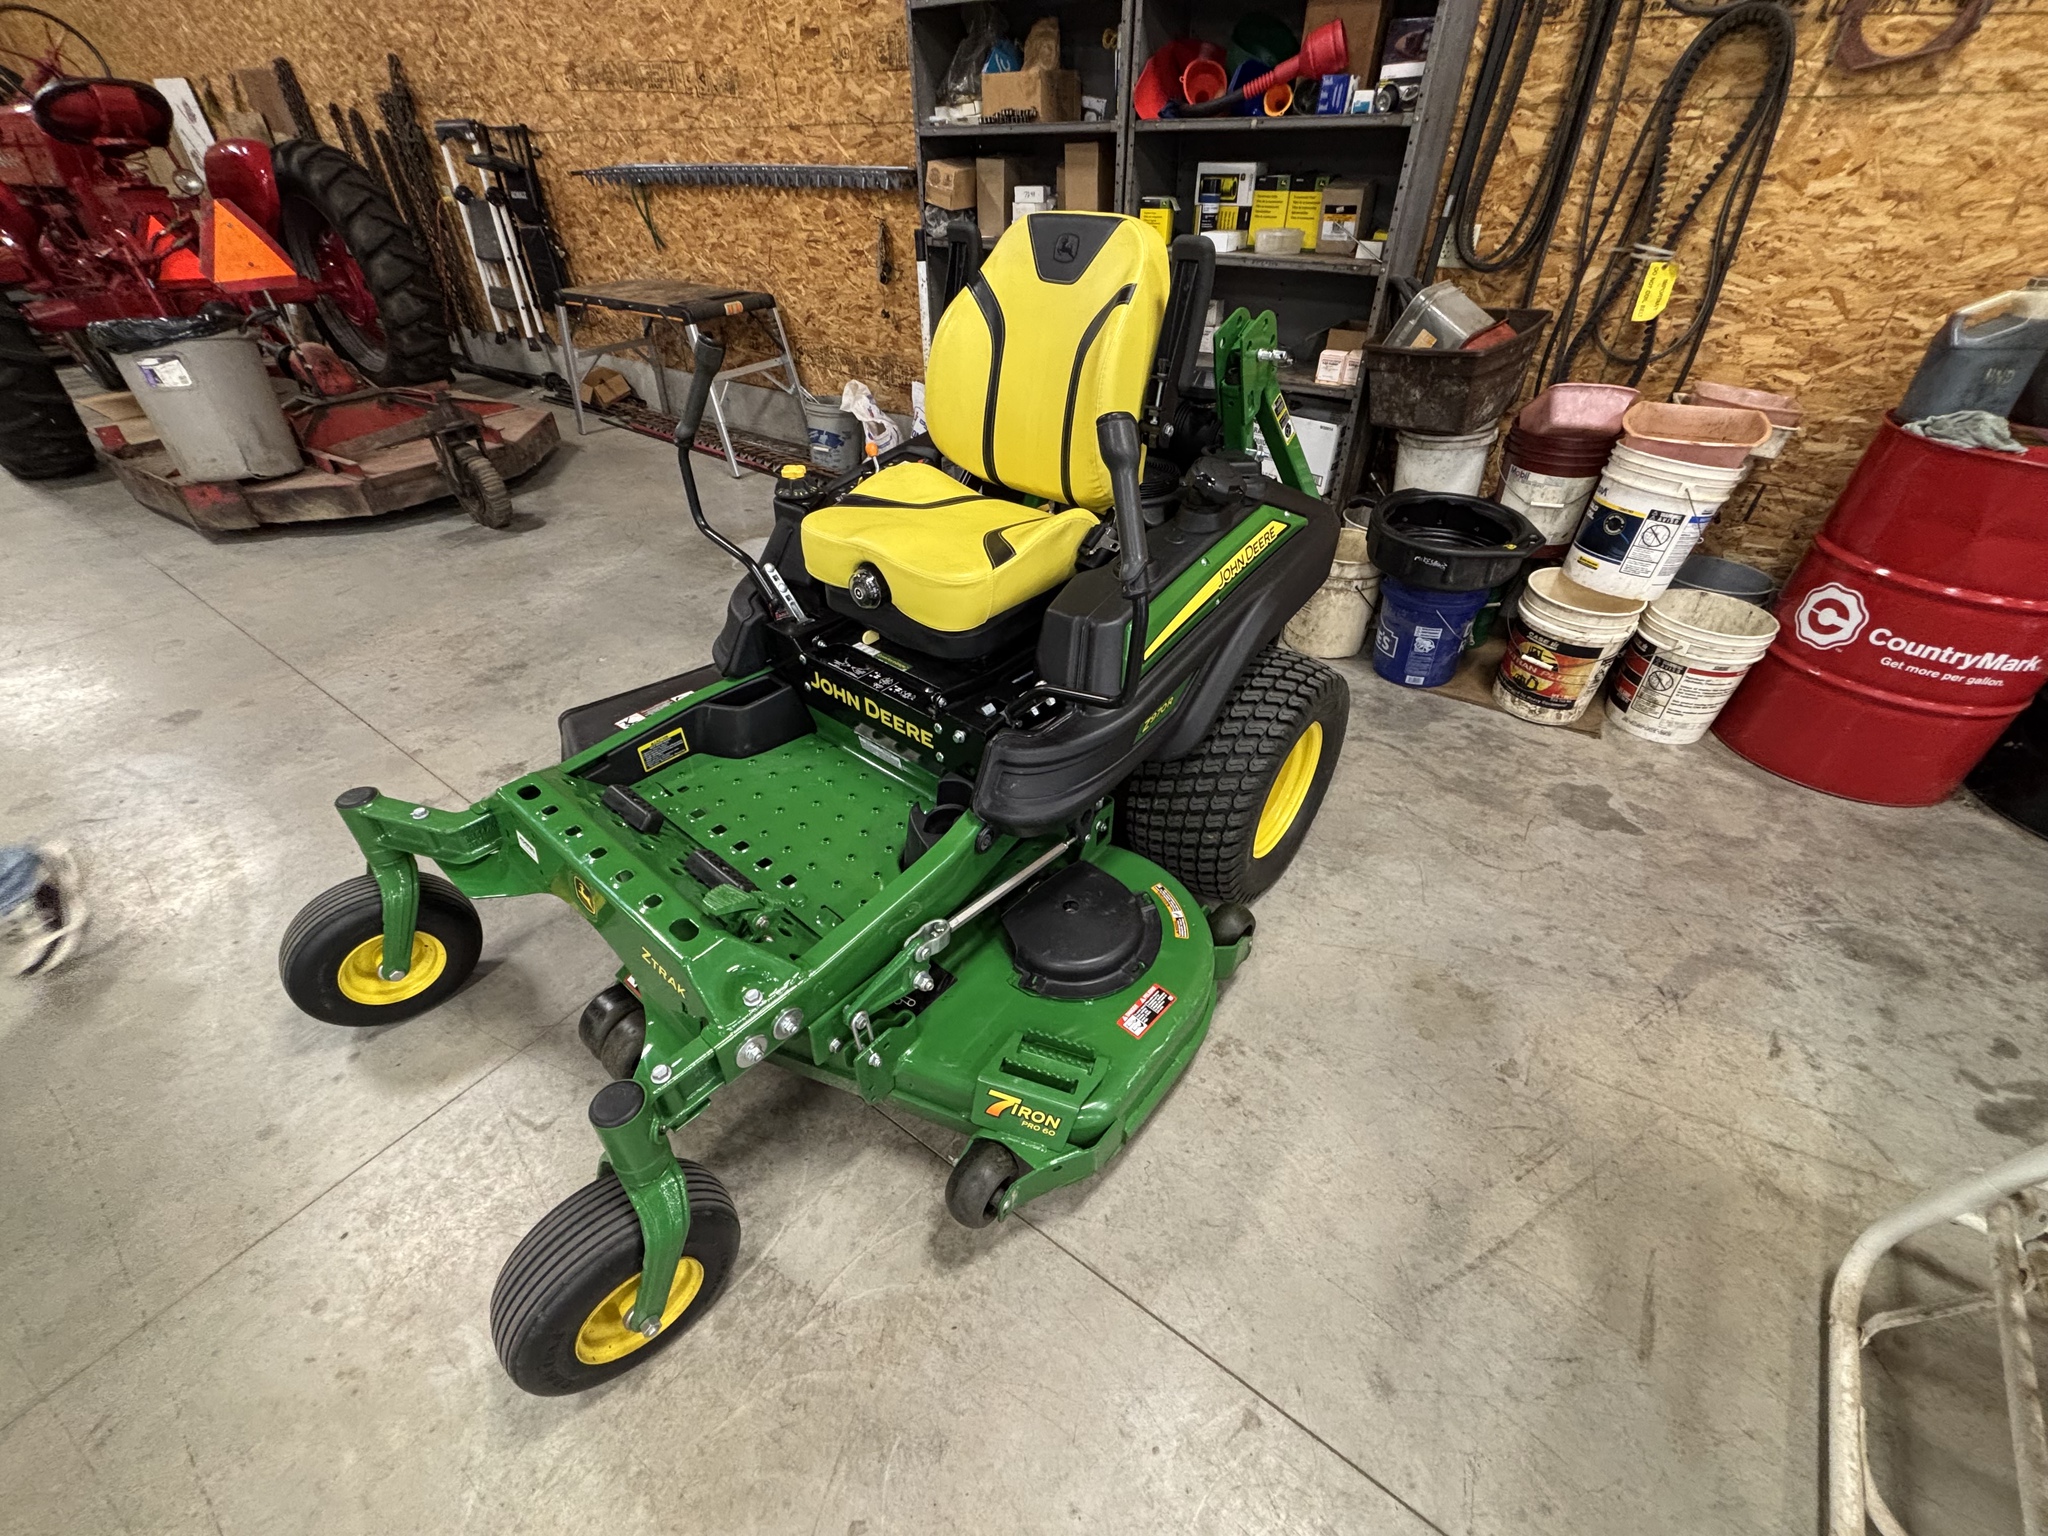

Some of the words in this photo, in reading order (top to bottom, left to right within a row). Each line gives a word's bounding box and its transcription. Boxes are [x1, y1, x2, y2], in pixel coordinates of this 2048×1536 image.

[1652, 267, 1659, 276] DO
[1642, 290, 1651, 303] COIL
[1510, 466, 1531, 481] Mobil
[1218, 554, 1246, 588] JOHN
[1245, 526, 1276, 562] DEERE
[1528, 631, 1551, 646] CASE
[1868, 628, 2043, 672] CountryMark
[1880, 656, 1905, 670] Get
[1904, 665, 1941, 679] more
[1940, 672, 1966, 683] per
[810, 671, 861, 711] JOHN
[864, 697, 935, 750] DEERE
[641, 946, 686, 999] ZTRAK
[1021, 1120, 1041, 1132] PRO
[1042, 1127, 1056, 1137] 60
